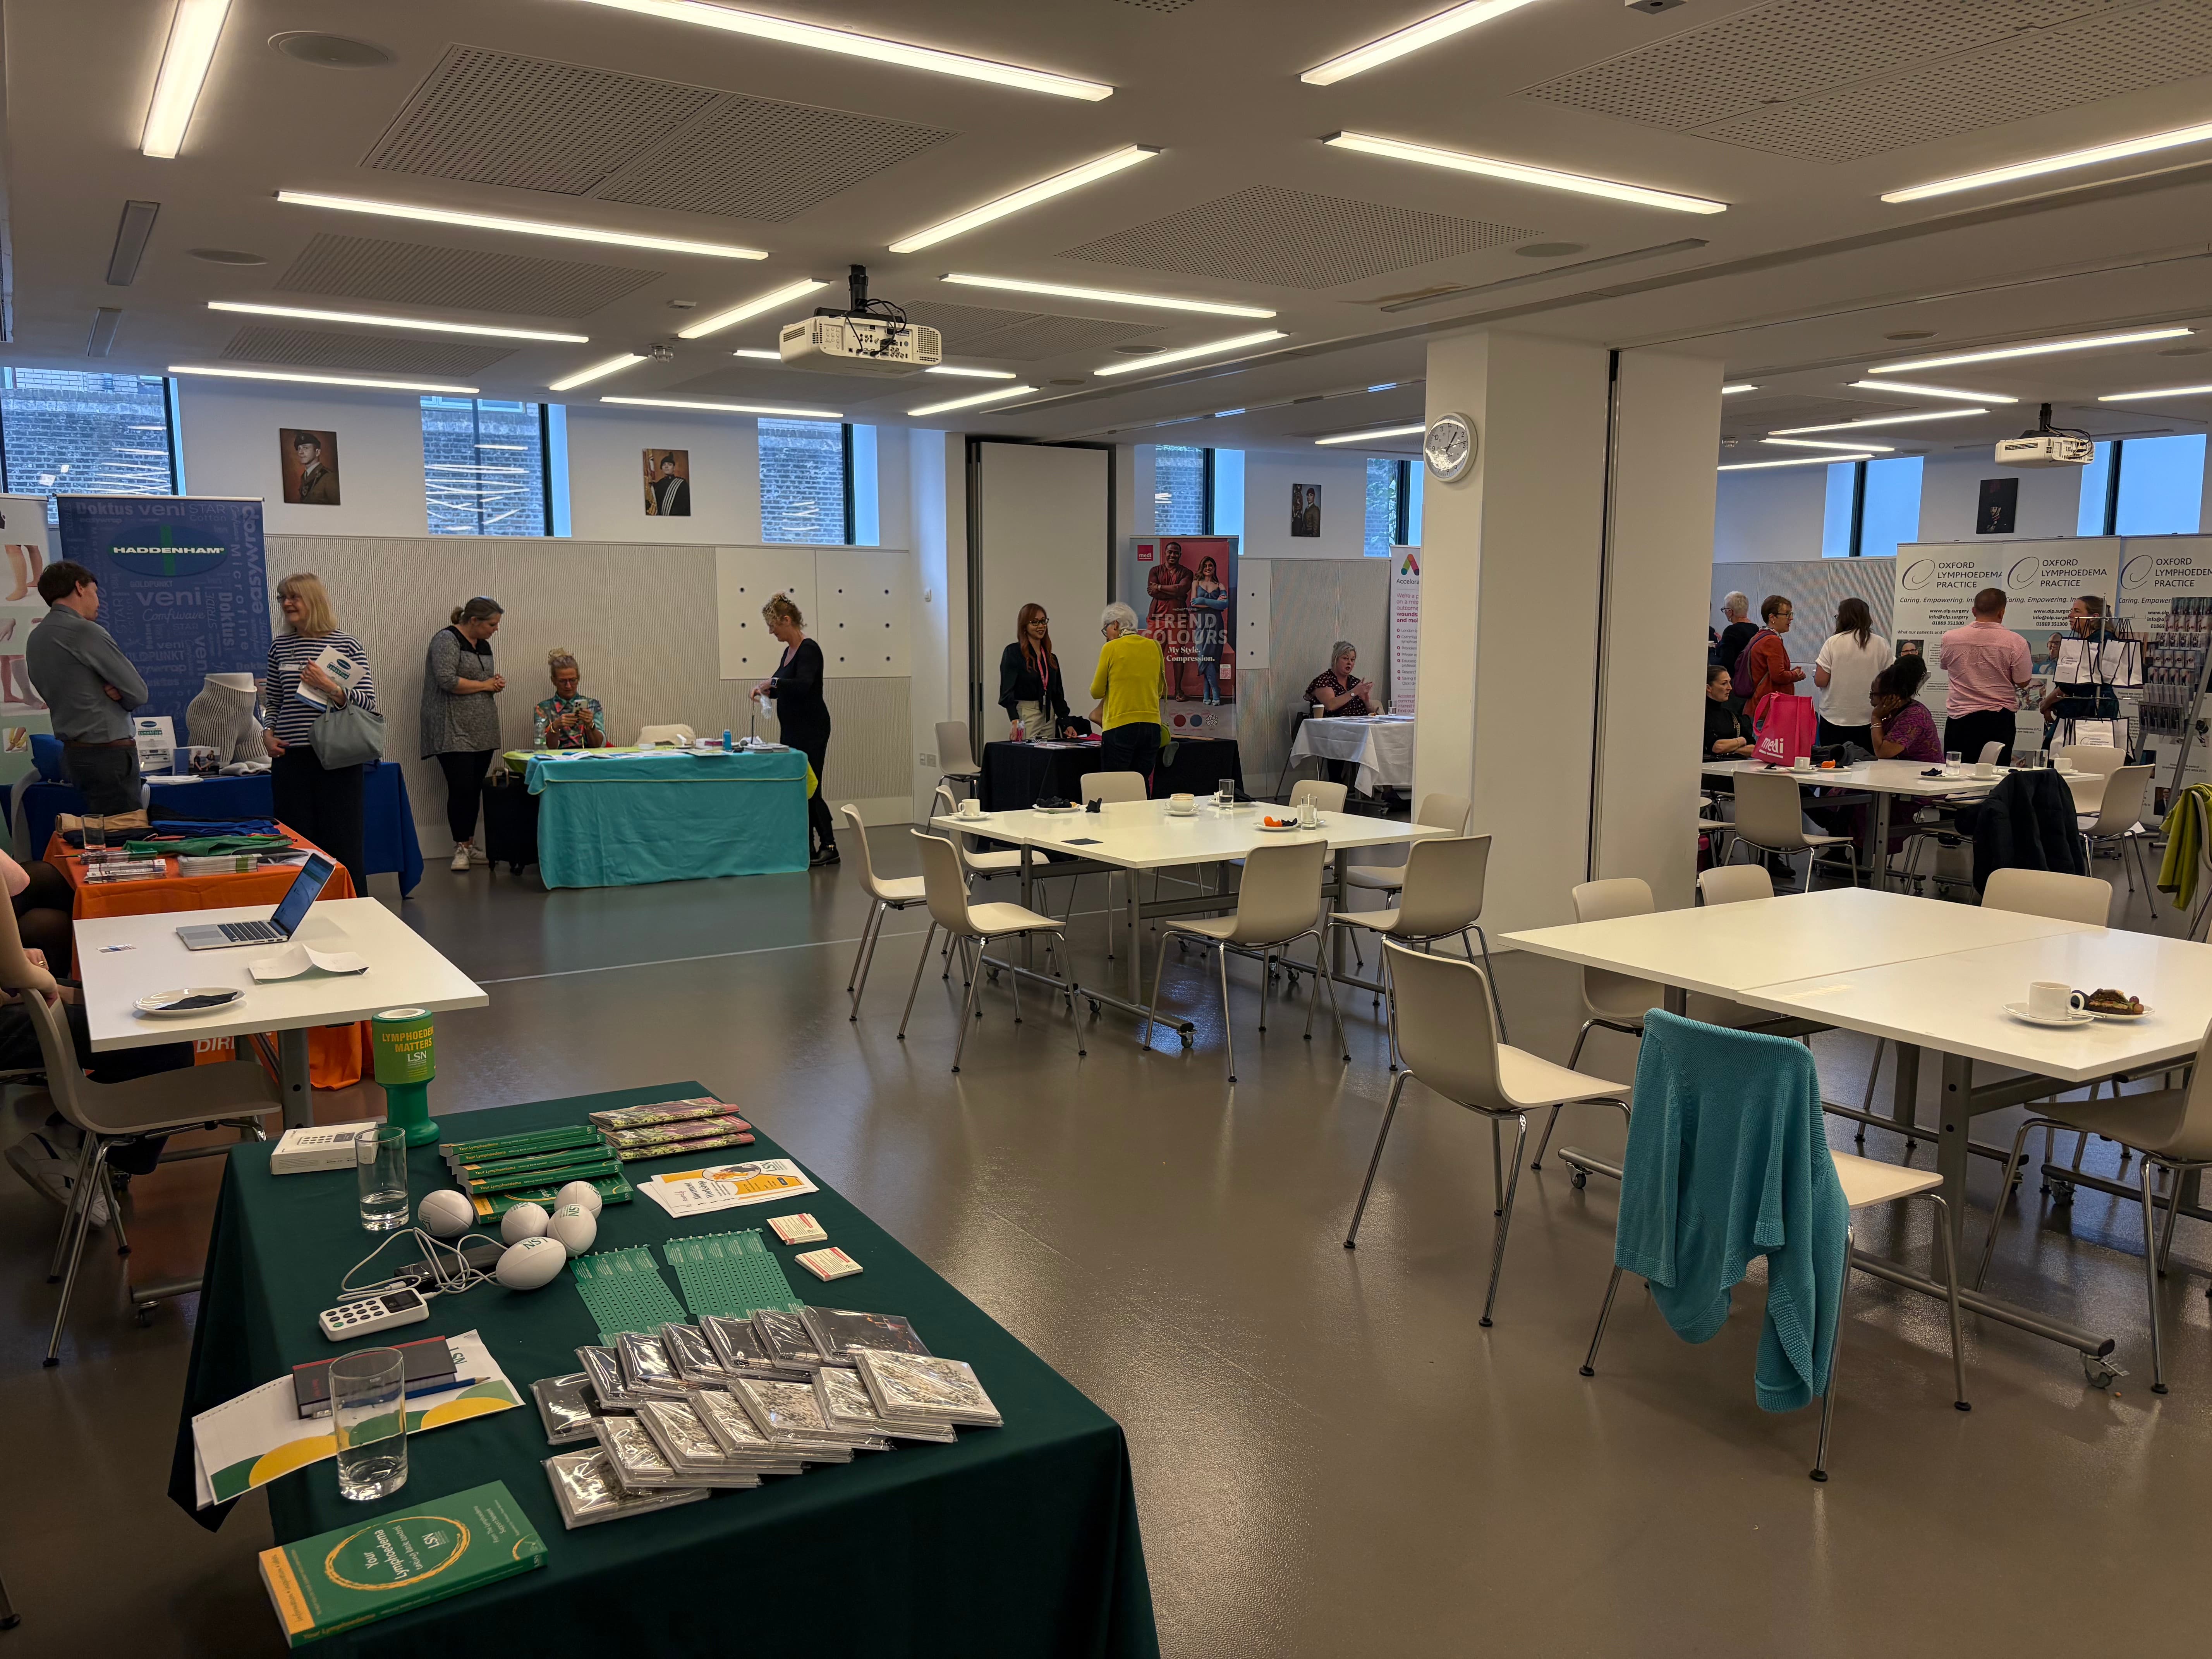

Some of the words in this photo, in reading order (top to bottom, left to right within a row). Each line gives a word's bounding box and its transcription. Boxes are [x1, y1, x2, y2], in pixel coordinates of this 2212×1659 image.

[77, 501, 133, 517] Doktus
[138, 503, 185, 516] veni
[189, 504, 225, 514] STAR
[242, 505, 264, 614] easywrap
[2041, 568, 2107, 577] LYMPHOEDEMA
[136, 587, 202, 606] veni
[205, 591, 217, 629] STRIDE
[218, 592, 235, 646] Doktus
[1151, 613, 1217, 628] TREND
[156, 640, 185, 649] veni
[1168, 647, 1180, 655] My
[1180, 646, 1200, 655] Style.
[1166, 655, 1215, 663] Compression.
[1761, 737, 1784, 754] medi
[395, 1037, 432, 1052] MATTERS
[407, 1050, 427, 1062] LSN
[476, 1151, 506, 1159] Lymphoedema
[759, 1162, 778, 1172] LSN
[490, 1181, 521, 1189] Lymphoedema
[684, 1182, 702, 1200] Movement
[698, 1180, 715, 1198] Workshop
[522, 1237, 549, 1250] LSN
[392, 1525, 408, 1542] control
[422, 1533, 440, 1549] LSN
[374, 1529, 410, 1580] Lymphoedema
[401, 1540, 414, 1554] back
[364, 1551, 379, 1570] Your
[409, 1551, 424, 1570] taking
